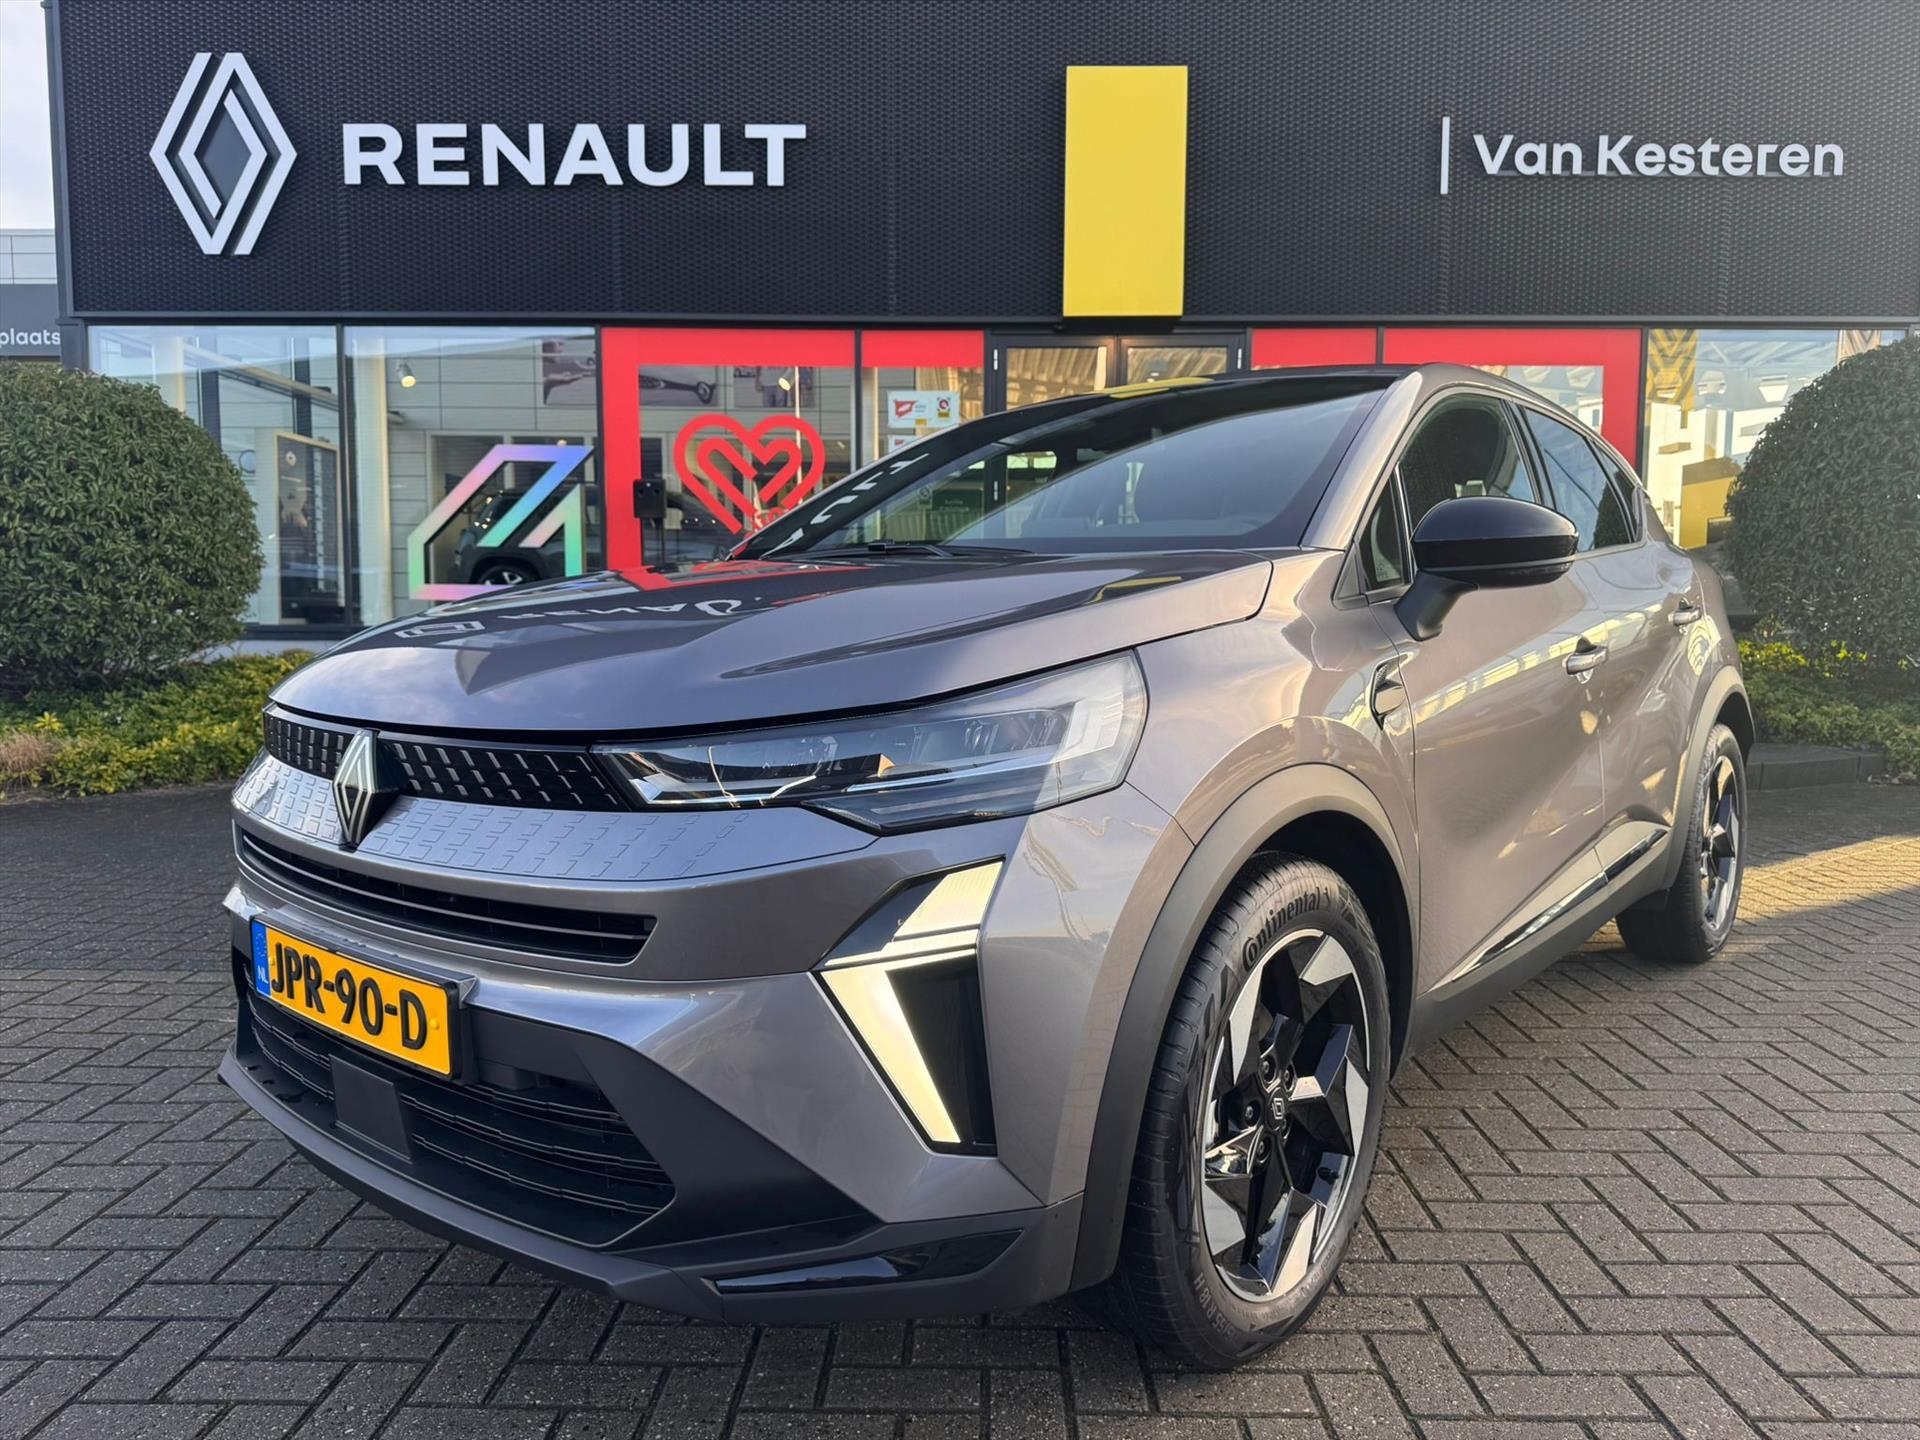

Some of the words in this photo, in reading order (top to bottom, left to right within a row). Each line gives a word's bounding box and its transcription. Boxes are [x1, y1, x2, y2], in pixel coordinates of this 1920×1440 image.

[342, 123, 807, 188] RENAULT
[1473, 133, 1583, 176] Van
[1597, 134, 1845, 177] Kesteren
[1242, 886, 1321, 972] Continental
[257, 964, 269, 985] NL
[271, 942, 428, 1050] JPR-90-D
